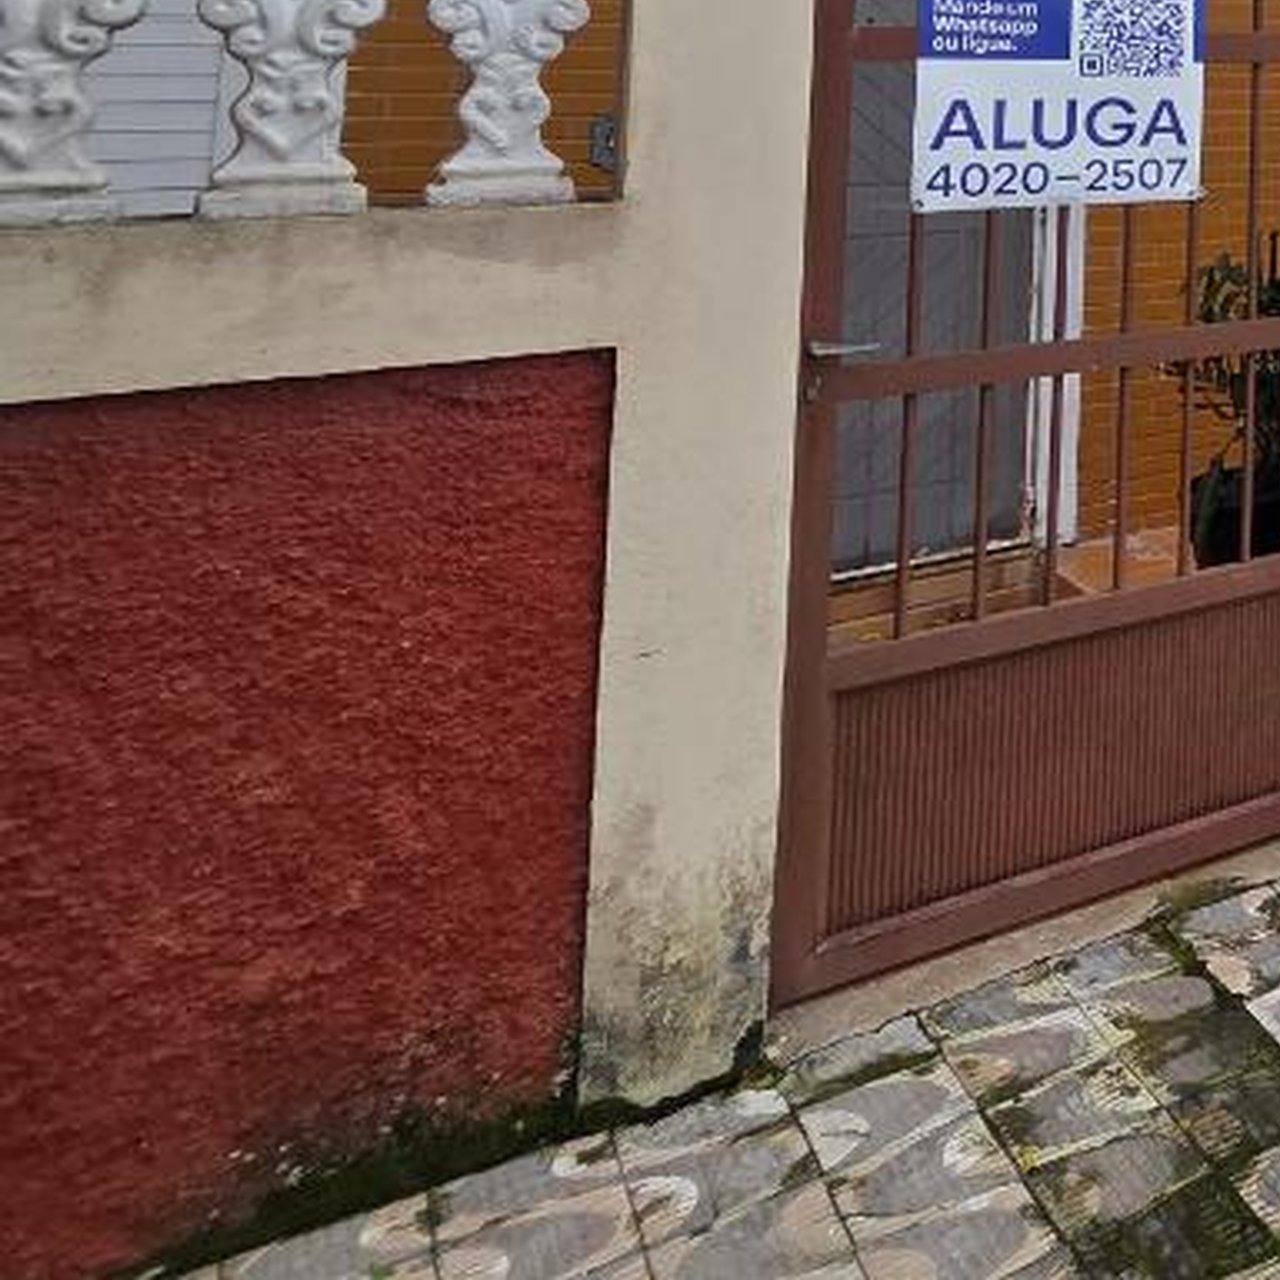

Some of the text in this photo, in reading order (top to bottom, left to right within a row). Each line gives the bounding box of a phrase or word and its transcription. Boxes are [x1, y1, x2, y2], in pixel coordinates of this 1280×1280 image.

[932, 16, 1038, 37] Whatsapp
[932, 36, 959, 52] ou
[930, 97, 1187, 151] ALUGA
[926, 158, 1188, 198] 4020-2507
